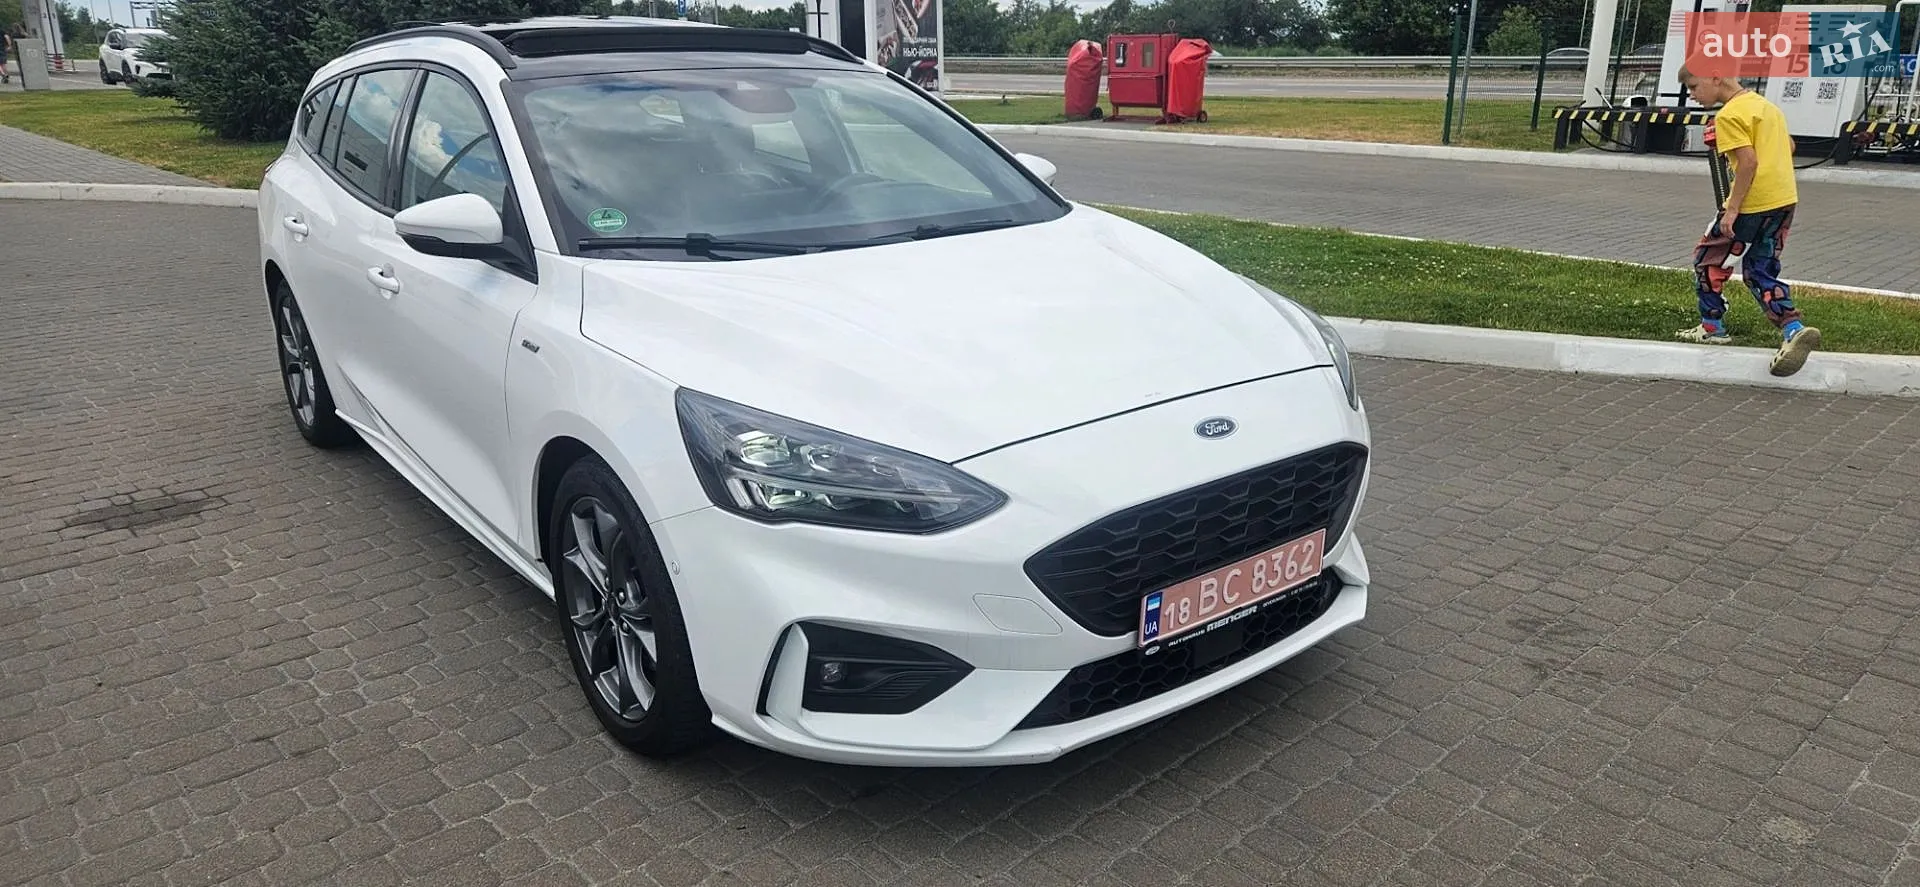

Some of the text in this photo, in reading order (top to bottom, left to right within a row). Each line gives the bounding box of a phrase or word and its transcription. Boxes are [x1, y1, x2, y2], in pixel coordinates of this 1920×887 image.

[1205, 421, 1229, 435] Ford
[1164, 539, 1315, 629] 18 BC 8362
[1145, 621, 1158, 635] UA
